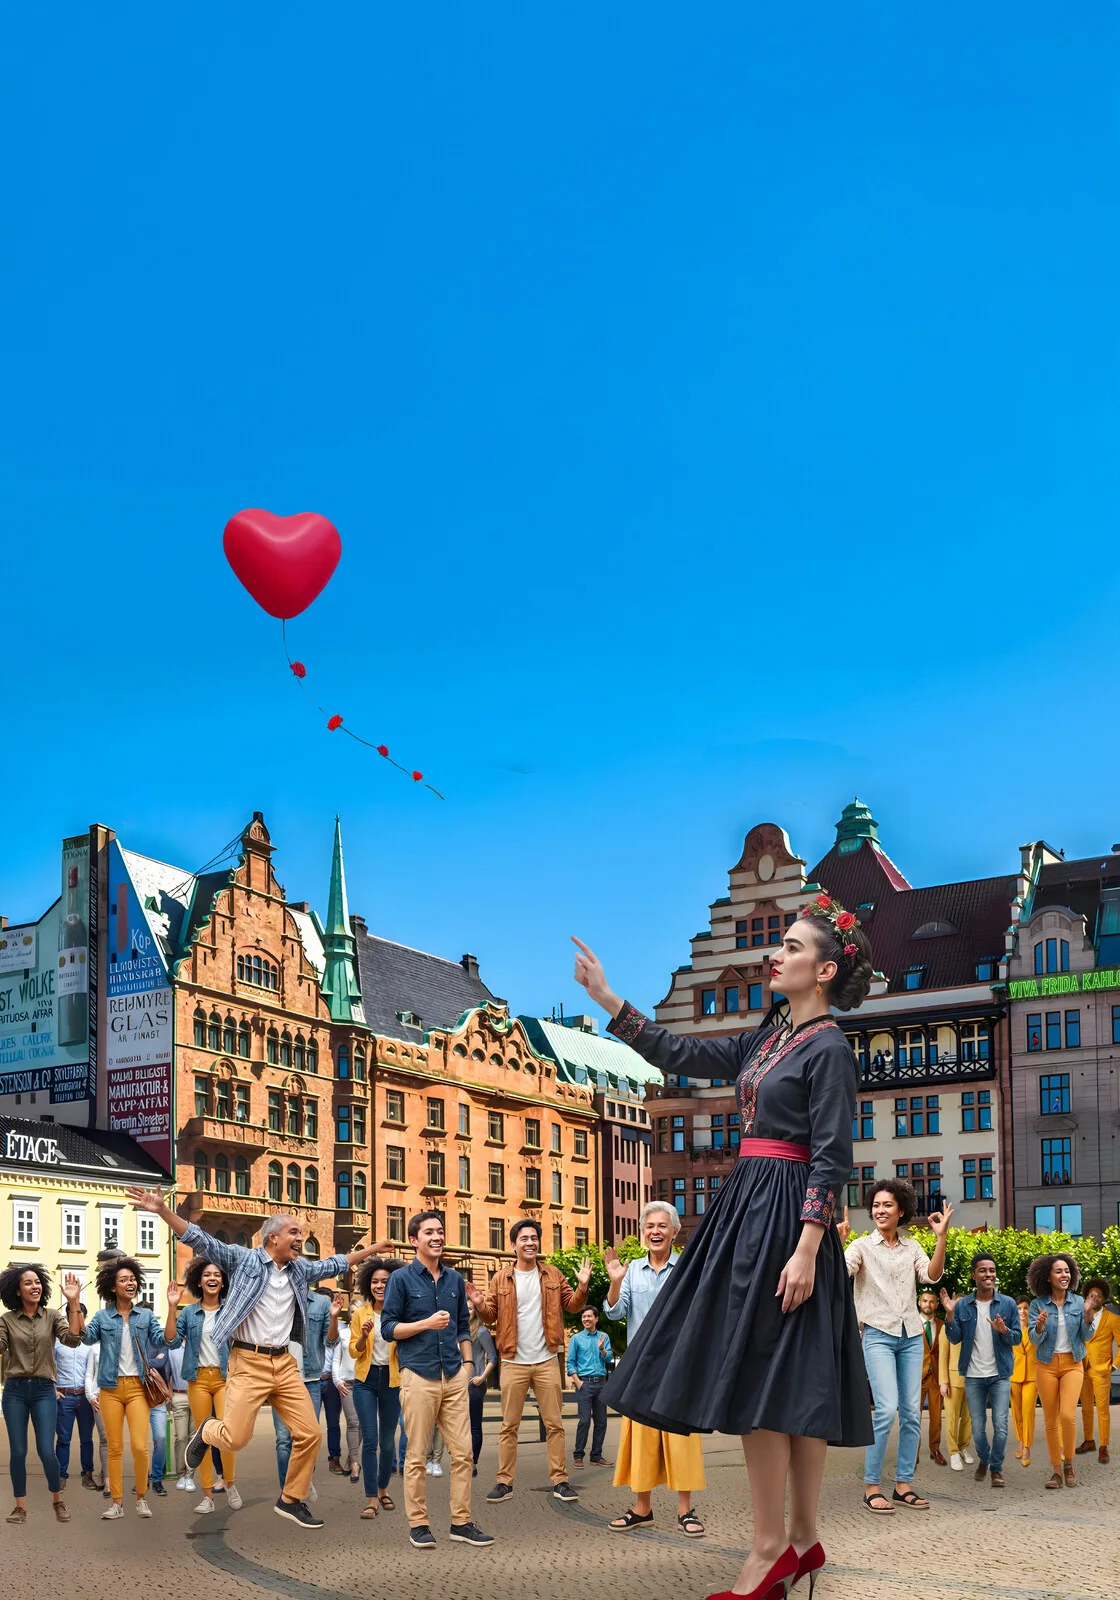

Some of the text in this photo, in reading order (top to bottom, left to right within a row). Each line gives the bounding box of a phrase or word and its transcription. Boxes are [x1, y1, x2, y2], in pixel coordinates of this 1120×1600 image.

[19, 969, 55, 1005] WOLKE
[1009, 980, 1038, 999] VIVA
[1041, 974, 1079, 995] FRIDA
[111, 1010, 168, 1033] GLAS
[5, 1130, 57, 1164] ÉTAGE
